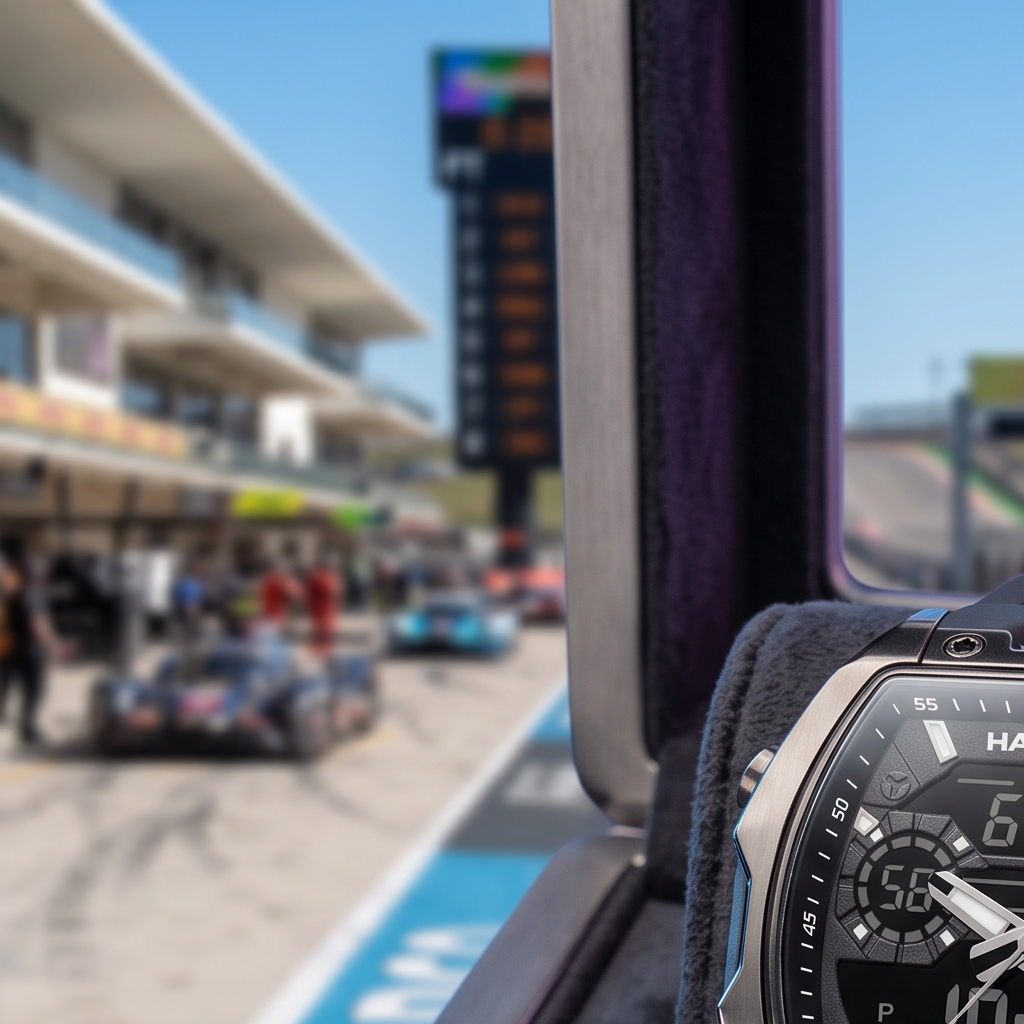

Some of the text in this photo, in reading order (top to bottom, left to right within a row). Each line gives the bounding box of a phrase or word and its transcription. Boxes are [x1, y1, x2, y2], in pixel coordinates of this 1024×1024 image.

[913, 697, 939, 711] 55
[831, 797, 850, 822] 50
[802, 910, 817, 938] 45
[877, 1002, 894, 1023] P
